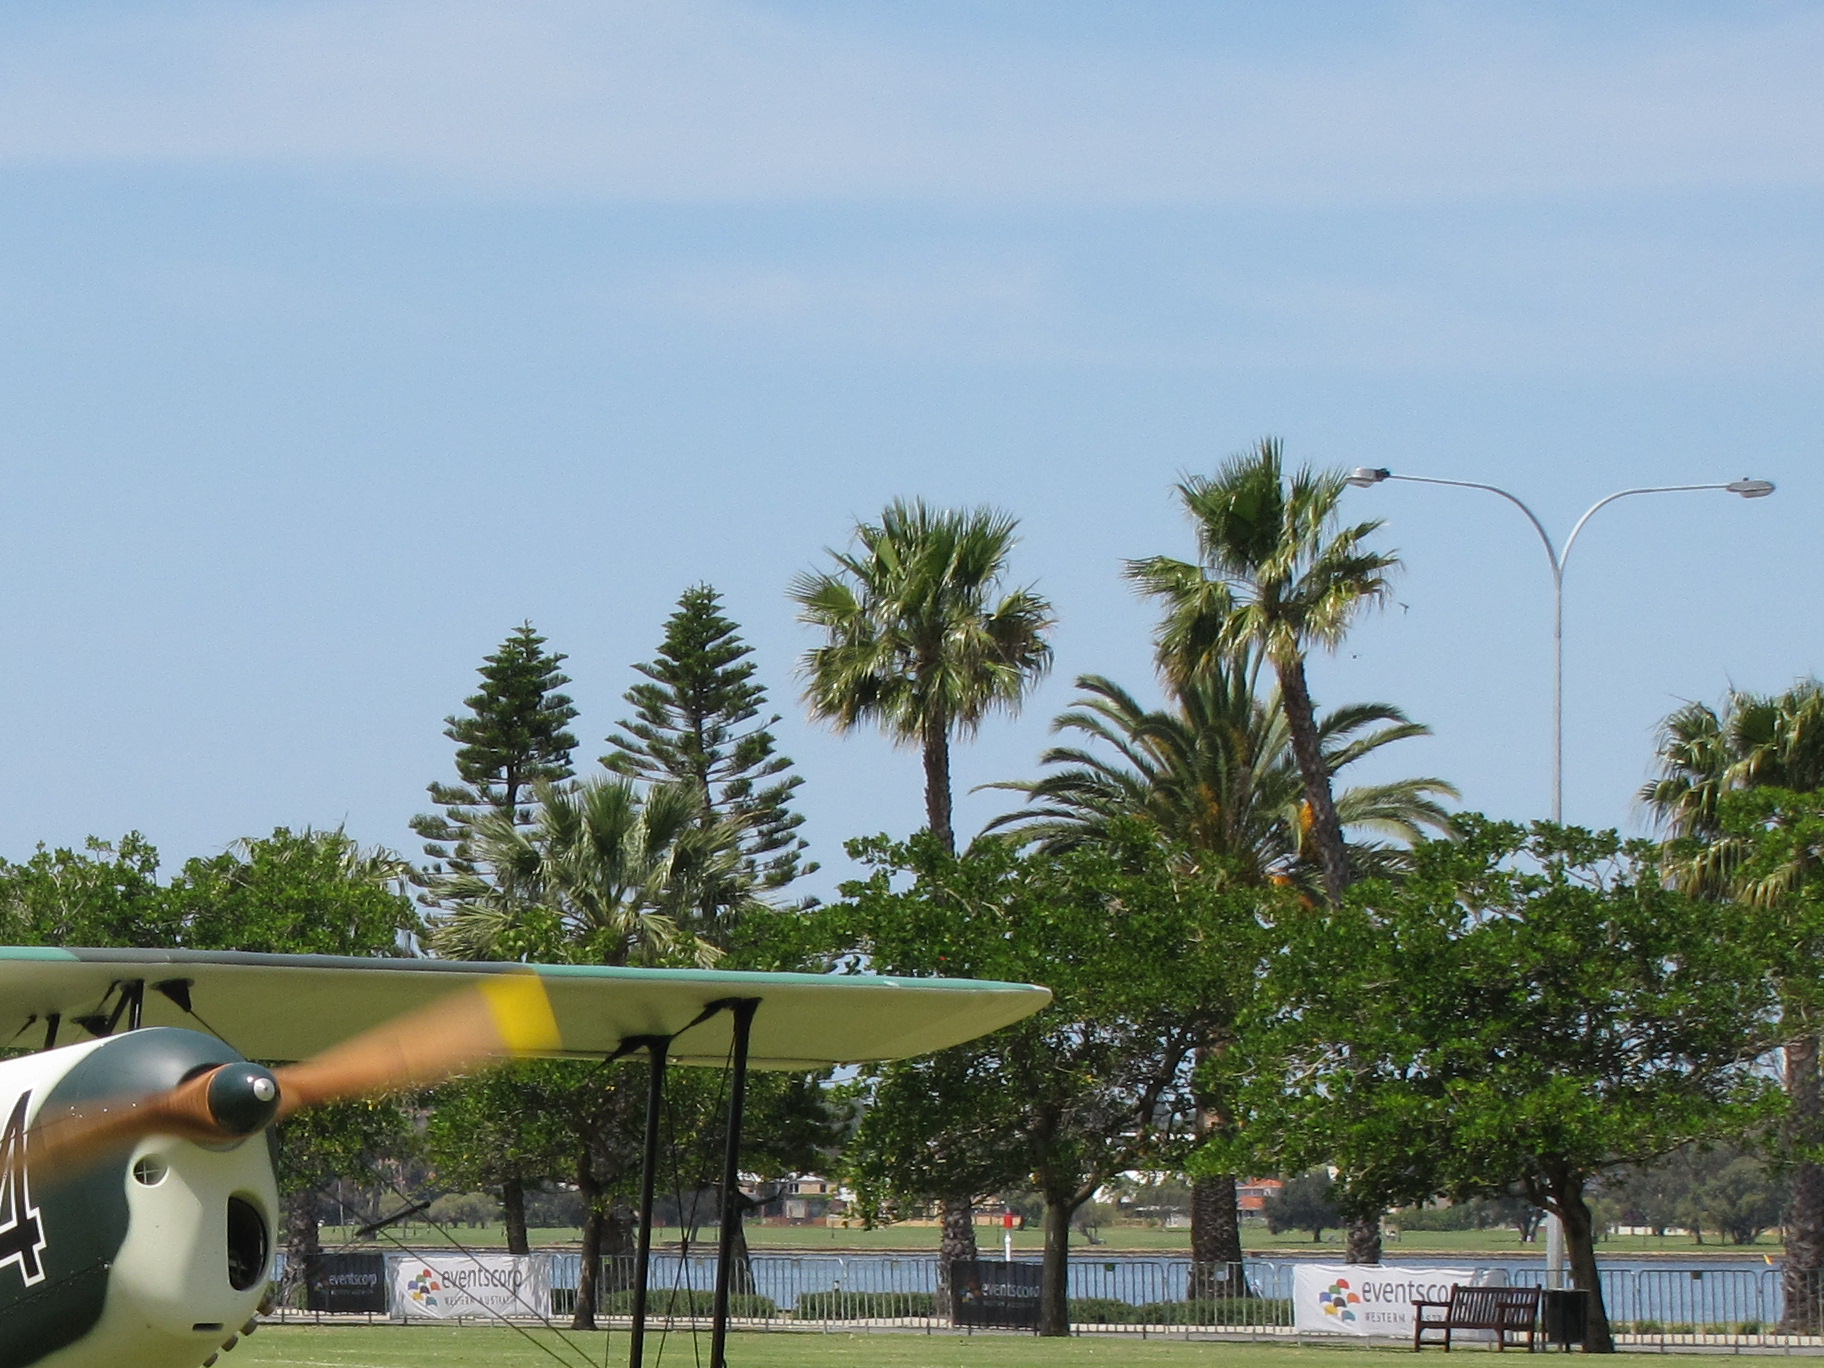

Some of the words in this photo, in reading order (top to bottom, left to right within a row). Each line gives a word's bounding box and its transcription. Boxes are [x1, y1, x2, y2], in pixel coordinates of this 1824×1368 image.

[328, 1272, 378, 1288] eventscorp
[441, 1266, 522, 1294] eventscorp
[1362, 1280, 1449, 1304] eventsco
[1364, 1311, 1405, 1323] WESTERN
